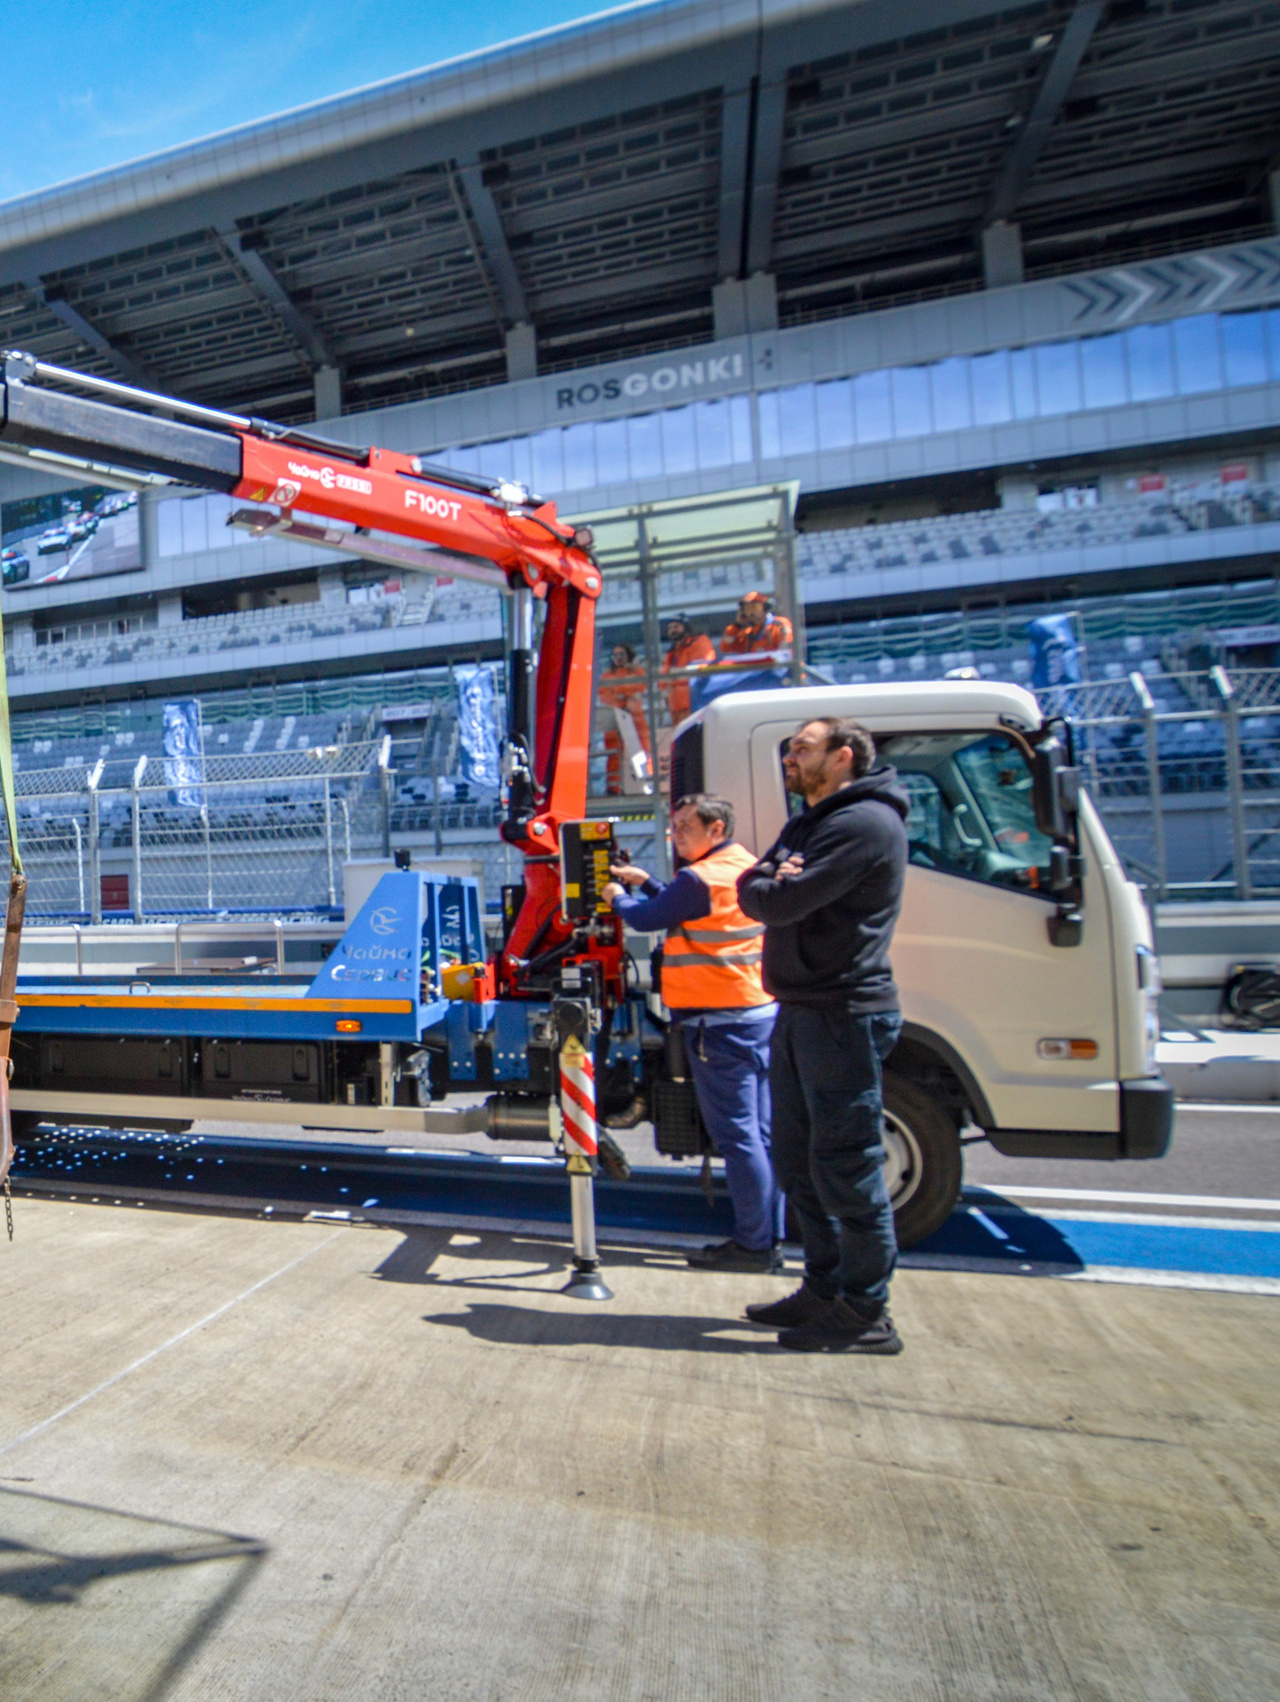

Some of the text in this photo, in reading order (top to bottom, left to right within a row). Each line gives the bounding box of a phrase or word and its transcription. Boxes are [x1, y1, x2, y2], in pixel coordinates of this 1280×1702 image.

[556, 353, 743, 410] ROSGONKI
[405, 489, 463, 521] F100T
[342, 945, 412, 960] Чайка
